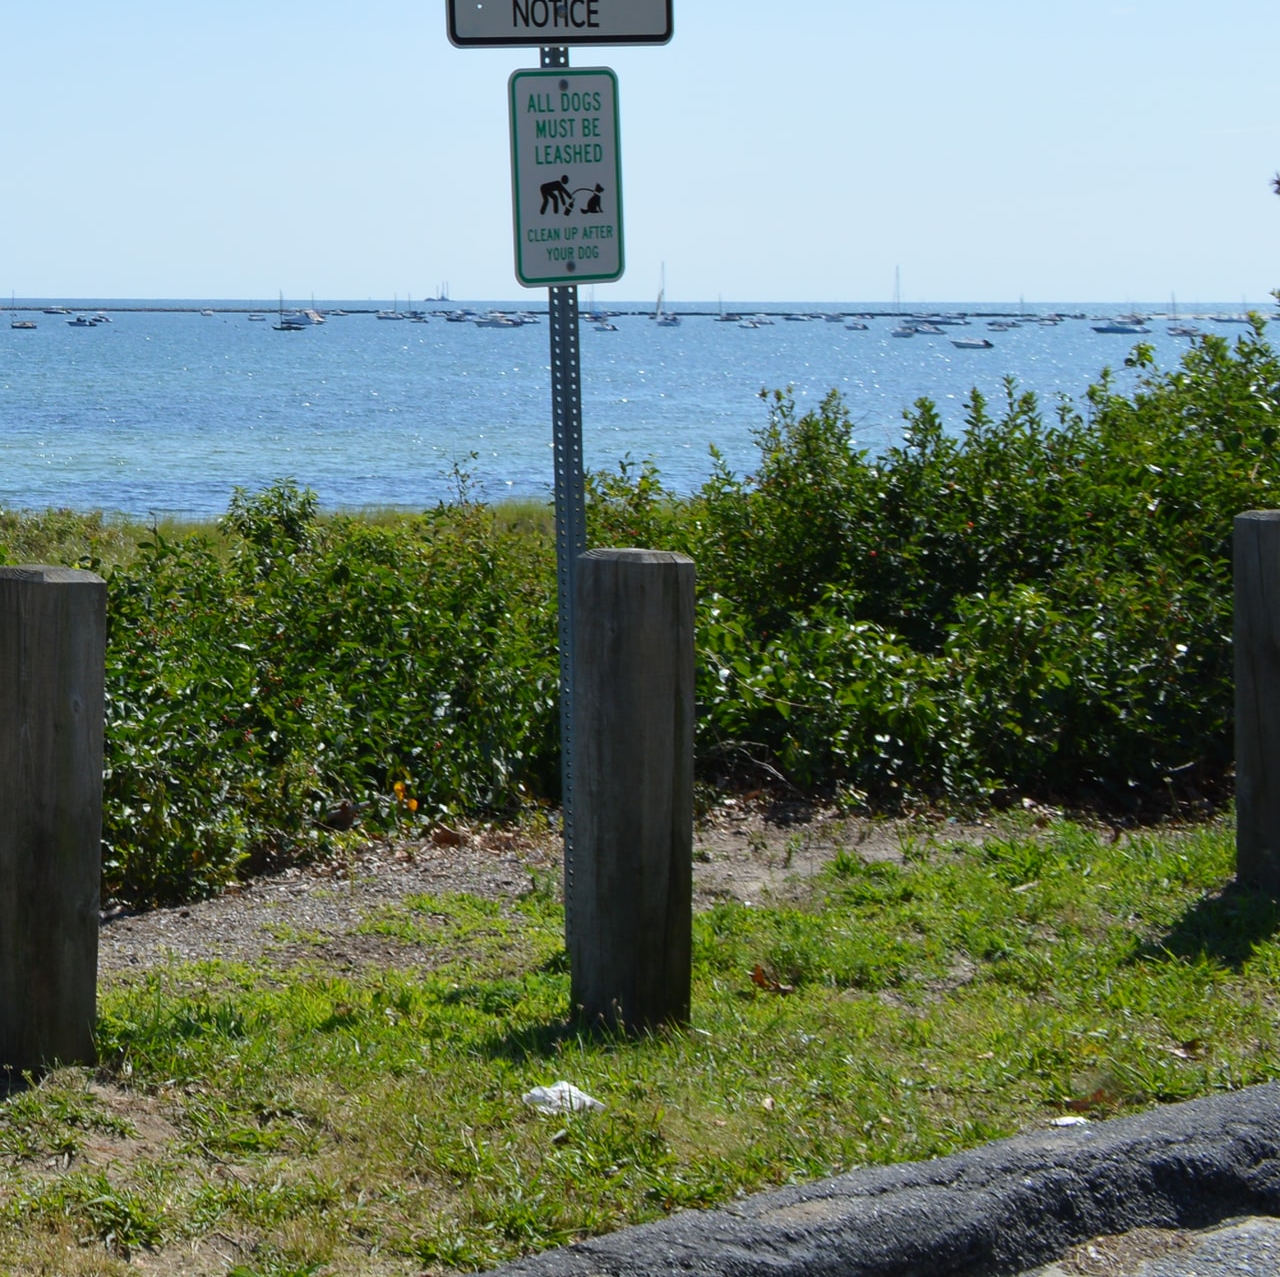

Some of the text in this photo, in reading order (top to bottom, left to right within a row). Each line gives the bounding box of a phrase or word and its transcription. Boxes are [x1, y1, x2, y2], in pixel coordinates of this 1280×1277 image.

[527, 92, 601, 113] ALL DOGS
[535, 118, 601, 139] MUST BE
[535, 144, 603, 165] LEASHED
[527, 225, 613, 243] CLEAN UP AFTER
[546, 245, 600, 261] YOUR DOG
